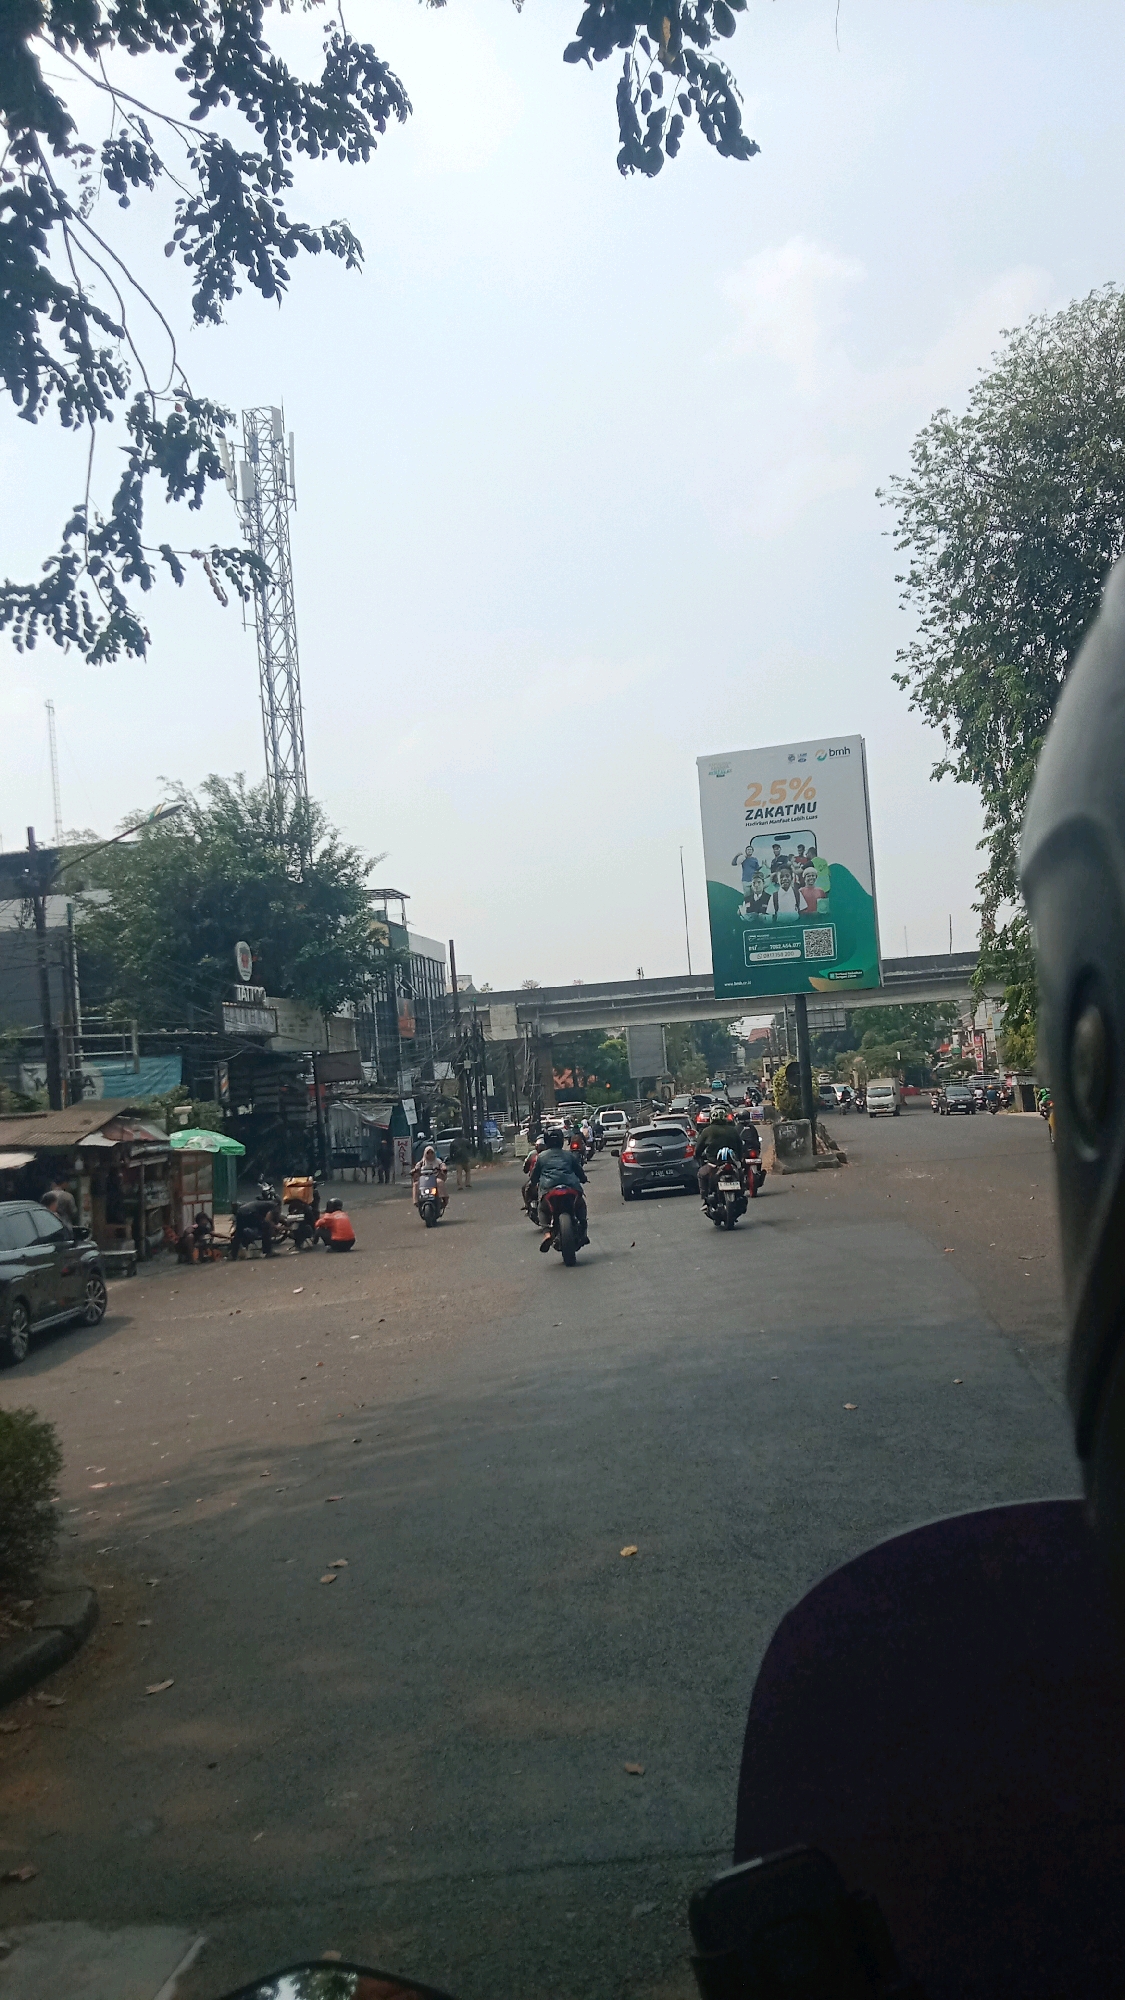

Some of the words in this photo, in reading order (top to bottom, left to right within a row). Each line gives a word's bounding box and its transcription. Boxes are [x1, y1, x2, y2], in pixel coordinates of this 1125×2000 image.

[828, 747, 851, 757] bmh
[744, 776, 816, 807] 2,5%
[745, 801, 817, 821] ZAKATMU
[769, 817, 790, 825] Manfaat
